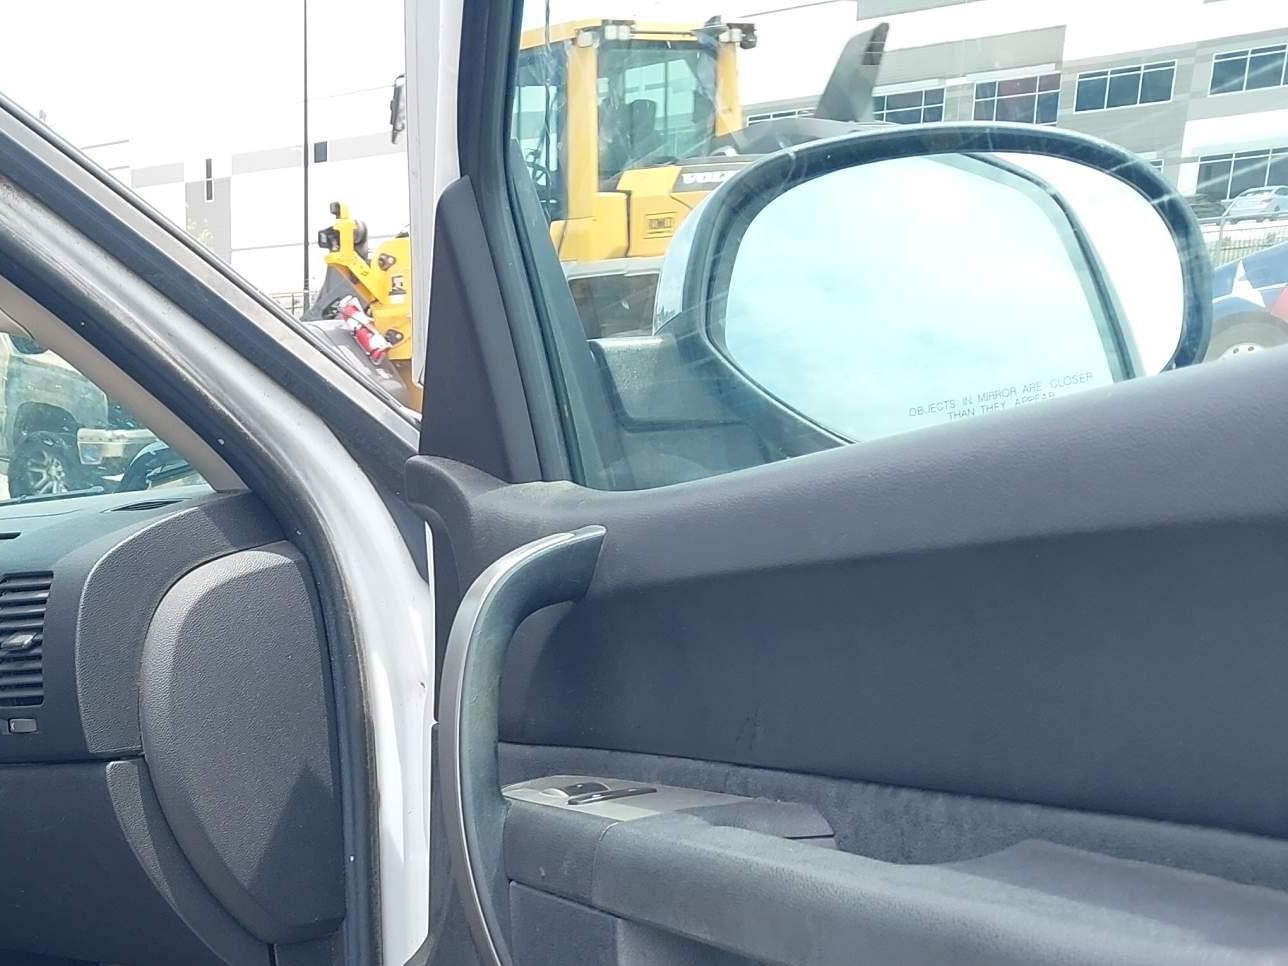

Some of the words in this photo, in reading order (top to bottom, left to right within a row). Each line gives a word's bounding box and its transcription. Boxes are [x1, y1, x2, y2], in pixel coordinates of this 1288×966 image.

[908, 399, 957, 417] OBJECTS
[962, 395, 973, 406] IN
[977, 386, 1017, 403] MIRROR
[1022, 381, 1043, 395] ARE
[1049, 371, 1094, 389] CLOSER
[946, 407, 976, 421] THAN
[980, 401, 1008, 415] THEY
